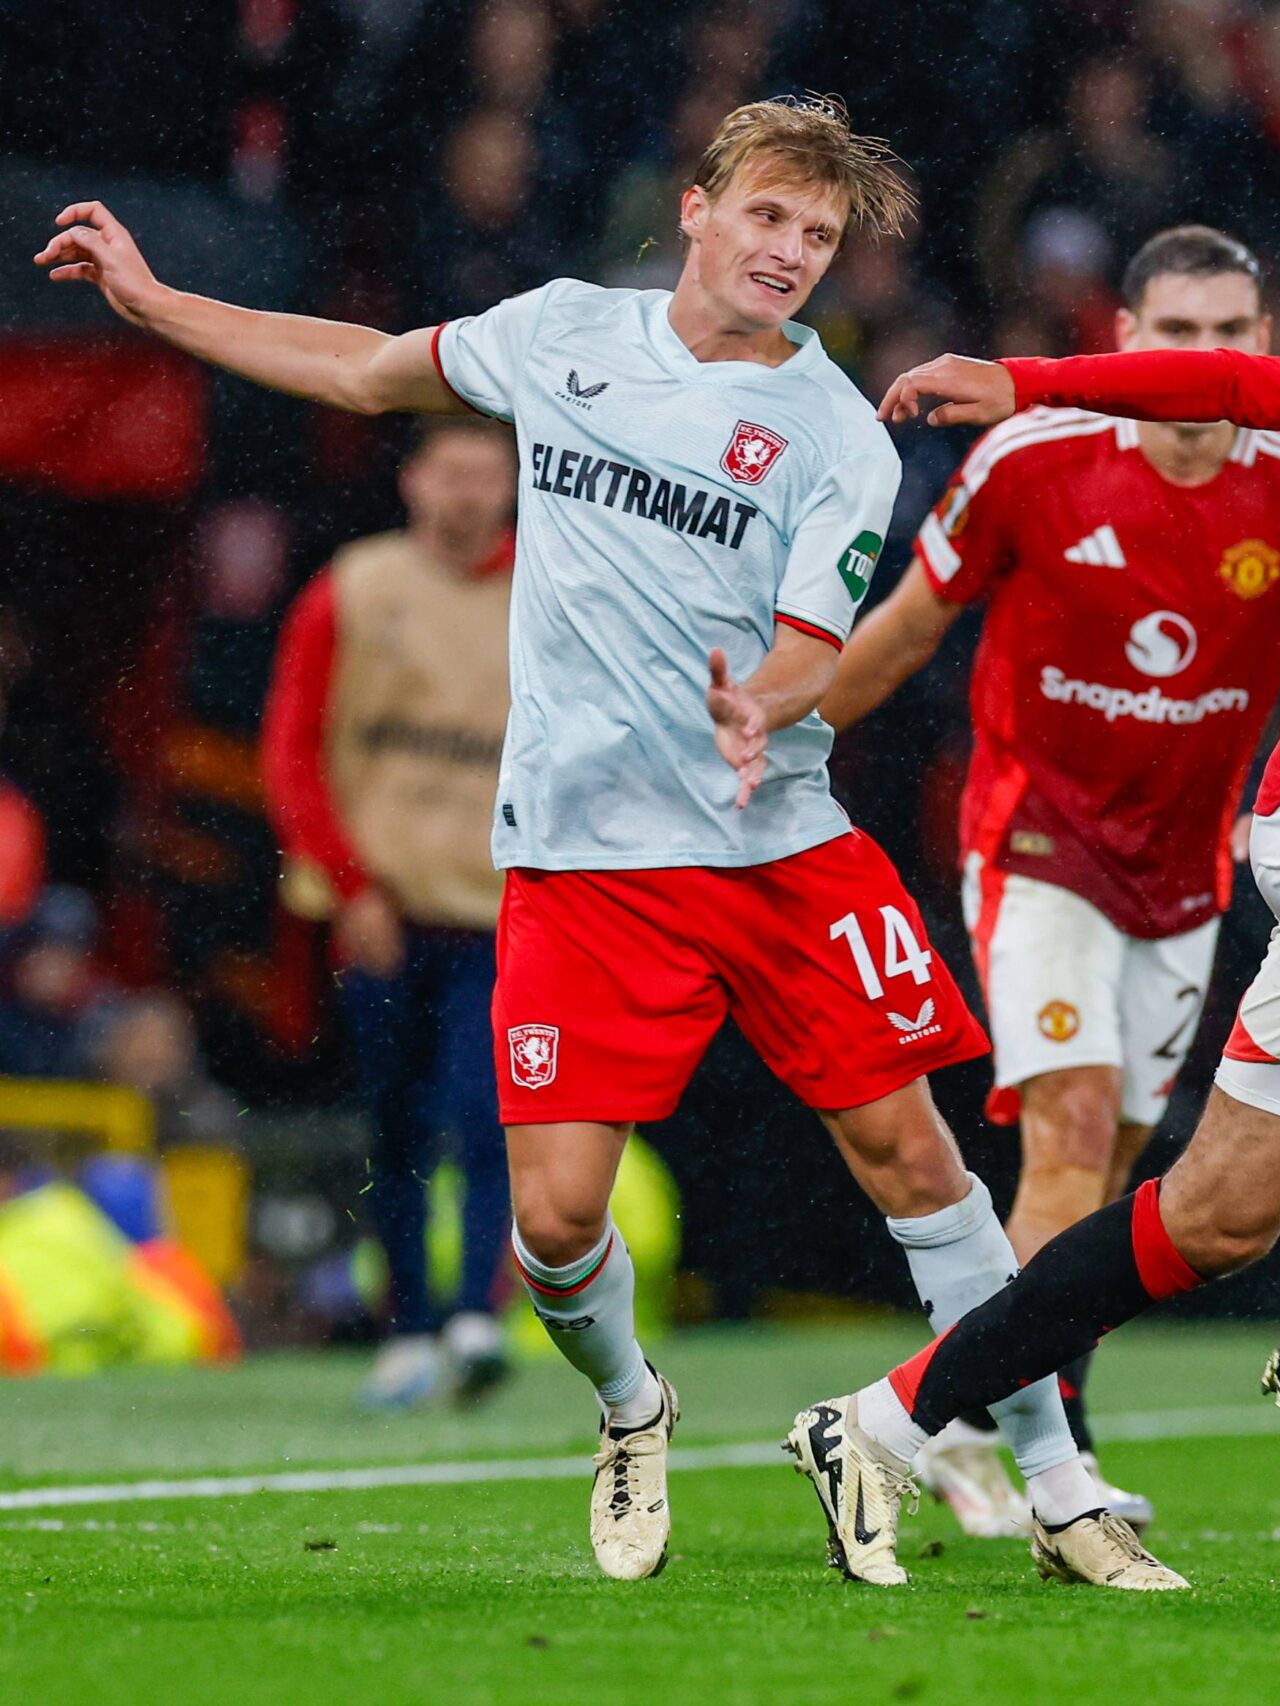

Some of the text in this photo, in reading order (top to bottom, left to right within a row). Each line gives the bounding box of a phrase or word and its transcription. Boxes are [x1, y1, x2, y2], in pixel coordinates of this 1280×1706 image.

[533, 443, 758, 550] ELEKTRAMAT
[829, 905, 932, 1001] 14
[898, 1024, 942, 1045] CASTORE
